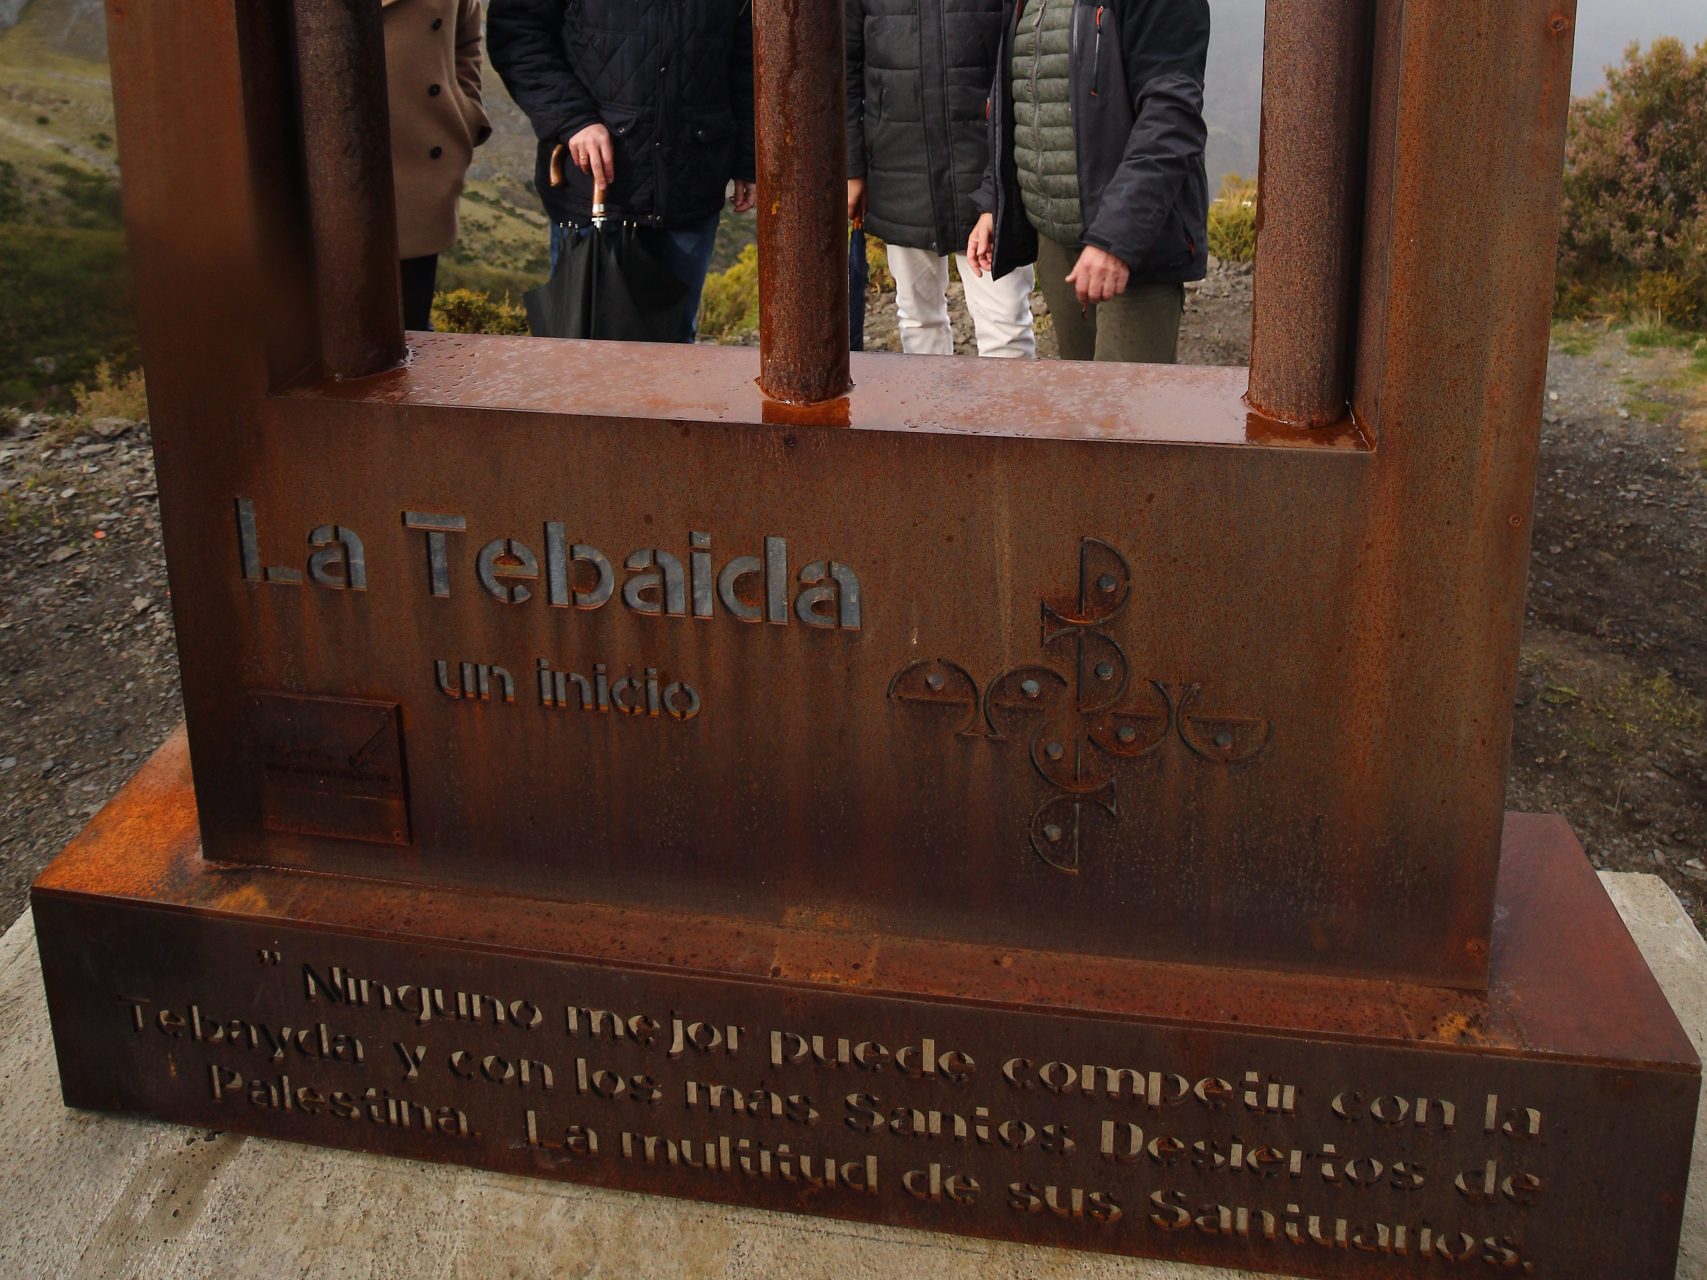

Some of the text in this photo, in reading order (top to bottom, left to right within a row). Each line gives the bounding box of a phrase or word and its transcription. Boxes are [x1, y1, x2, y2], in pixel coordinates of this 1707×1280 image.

[235, 498, 861, 631] La Tebaida
[434, 658, 700, 721] un inicio
[118, 994, 364, 1063] Tebayda
[393, 1042, 427, 1082] y
[448, 1050, 553, 1089] con
[575, 1057, 663, 1104] los
[845, 1092, 1076, 1156] Santos
[1100, 1119, 1428, 1192] Desiertos
[1454, 1159, 1543, 1205] de
[302, 963, 543, 1030] Ninguno
[566, 1006, 745, 1058] mejor
[770, 1029, 976, 1081] puede
[1001, 1057, 1302, 1118] competir
[1331, 1091, 1456, 1129] con
[1483, 1094, 1541, 1134] la
[207, 1063, 1535, 1270] Palestina. La multitud de sus Santuarios.
